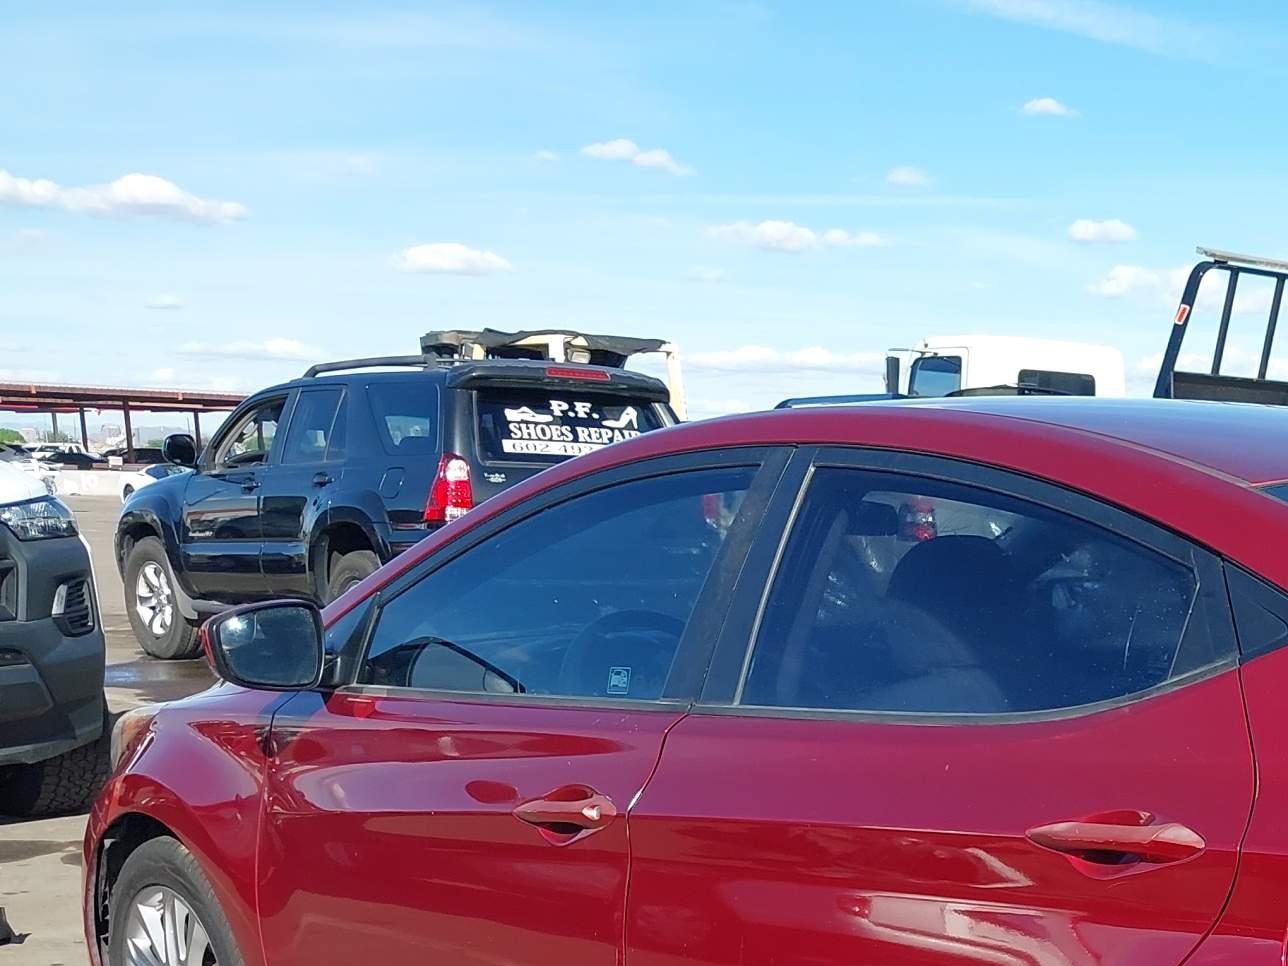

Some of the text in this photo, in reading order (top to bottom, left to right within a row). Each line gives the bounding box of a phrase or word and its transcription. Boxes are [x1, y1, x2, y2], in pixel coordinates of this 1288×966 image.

[550, 400, 600, 420] P.F.
[508, 423, 574, 442] SHOES
[512, 442, 550, 453] 602
